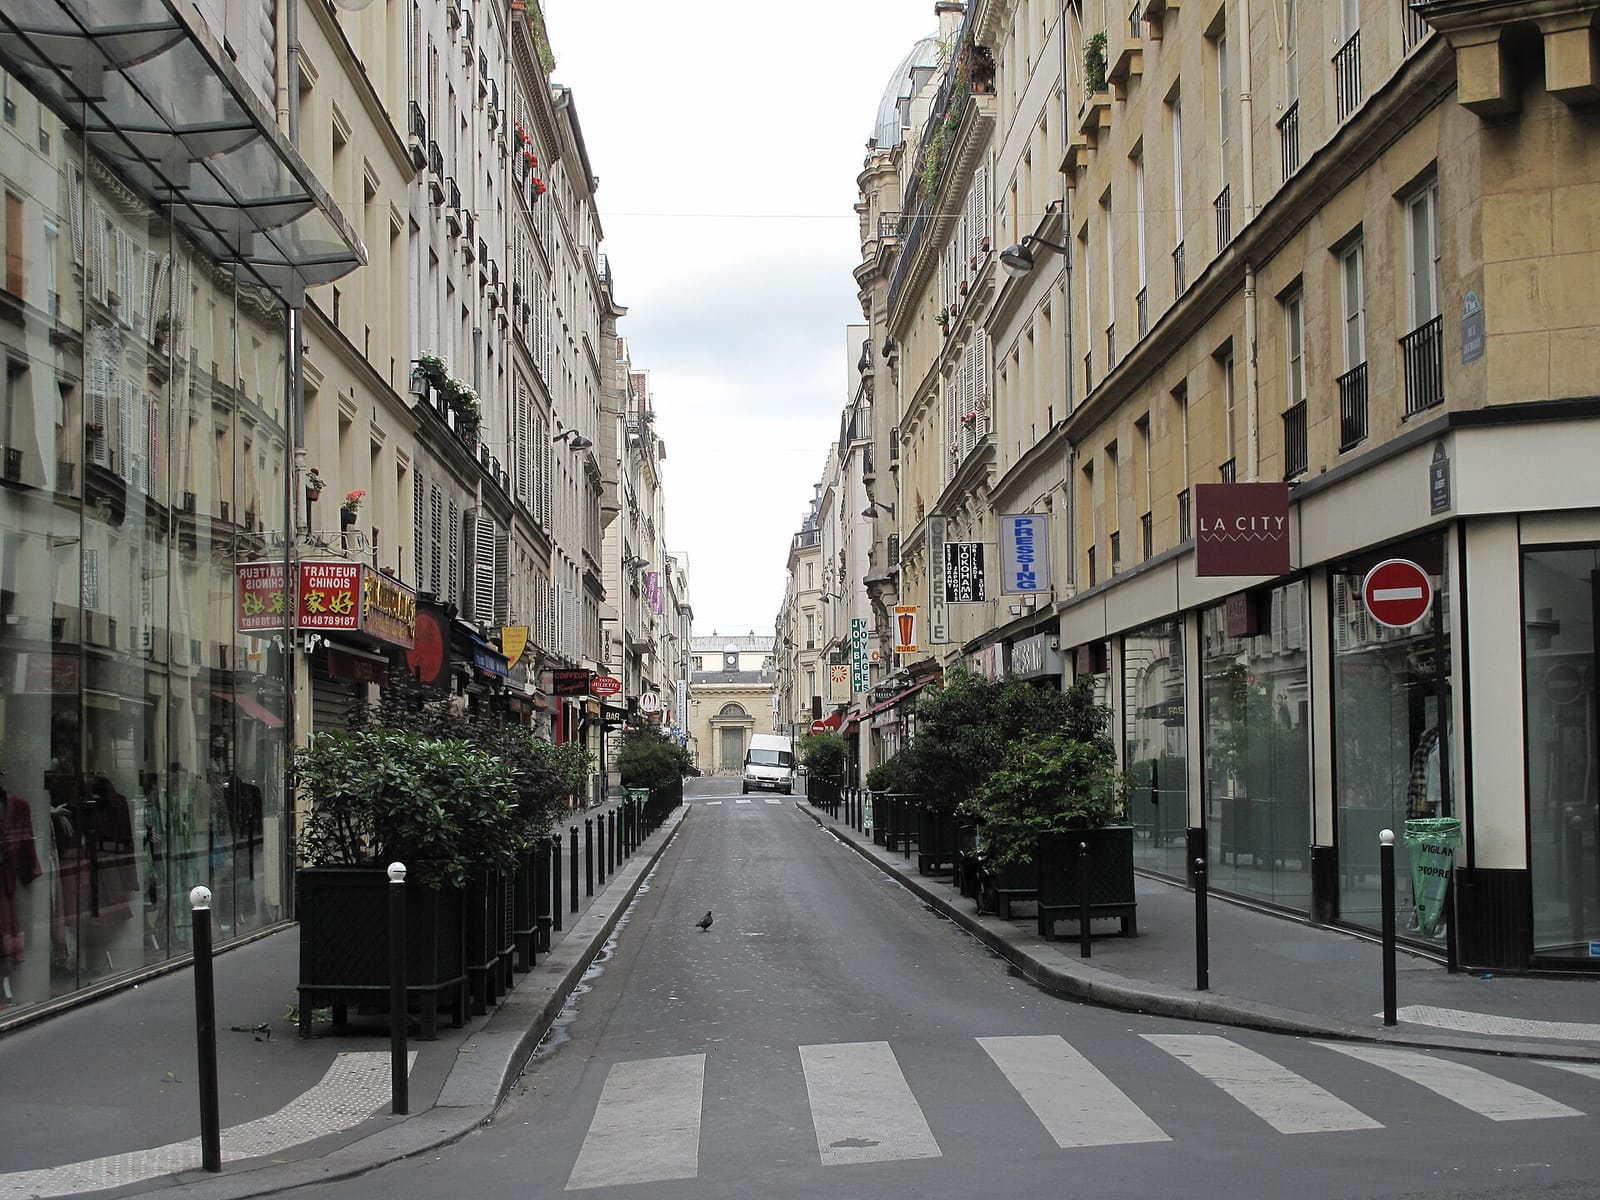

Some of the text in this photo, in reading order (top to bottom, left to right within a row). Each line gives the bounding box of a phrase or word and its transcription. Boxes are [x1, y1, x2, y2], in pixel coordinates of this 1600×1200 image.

[1200, 516, 1285, 532] LA CITY
[1014, 519, 1037, 590] PRESSING
[304, 566, 357, 578] TRAITEUR
[960, 545, 970, 599] YOKOHAMA
[309, 578, 351, 588] CHINOIS
[852, 619, 861, 691] JOUBERT
[860, 620, 869, 692] VOYAGES
[554, 671, 588, 680] COIFFEUR
[605, 711, 620, 721] BAR
